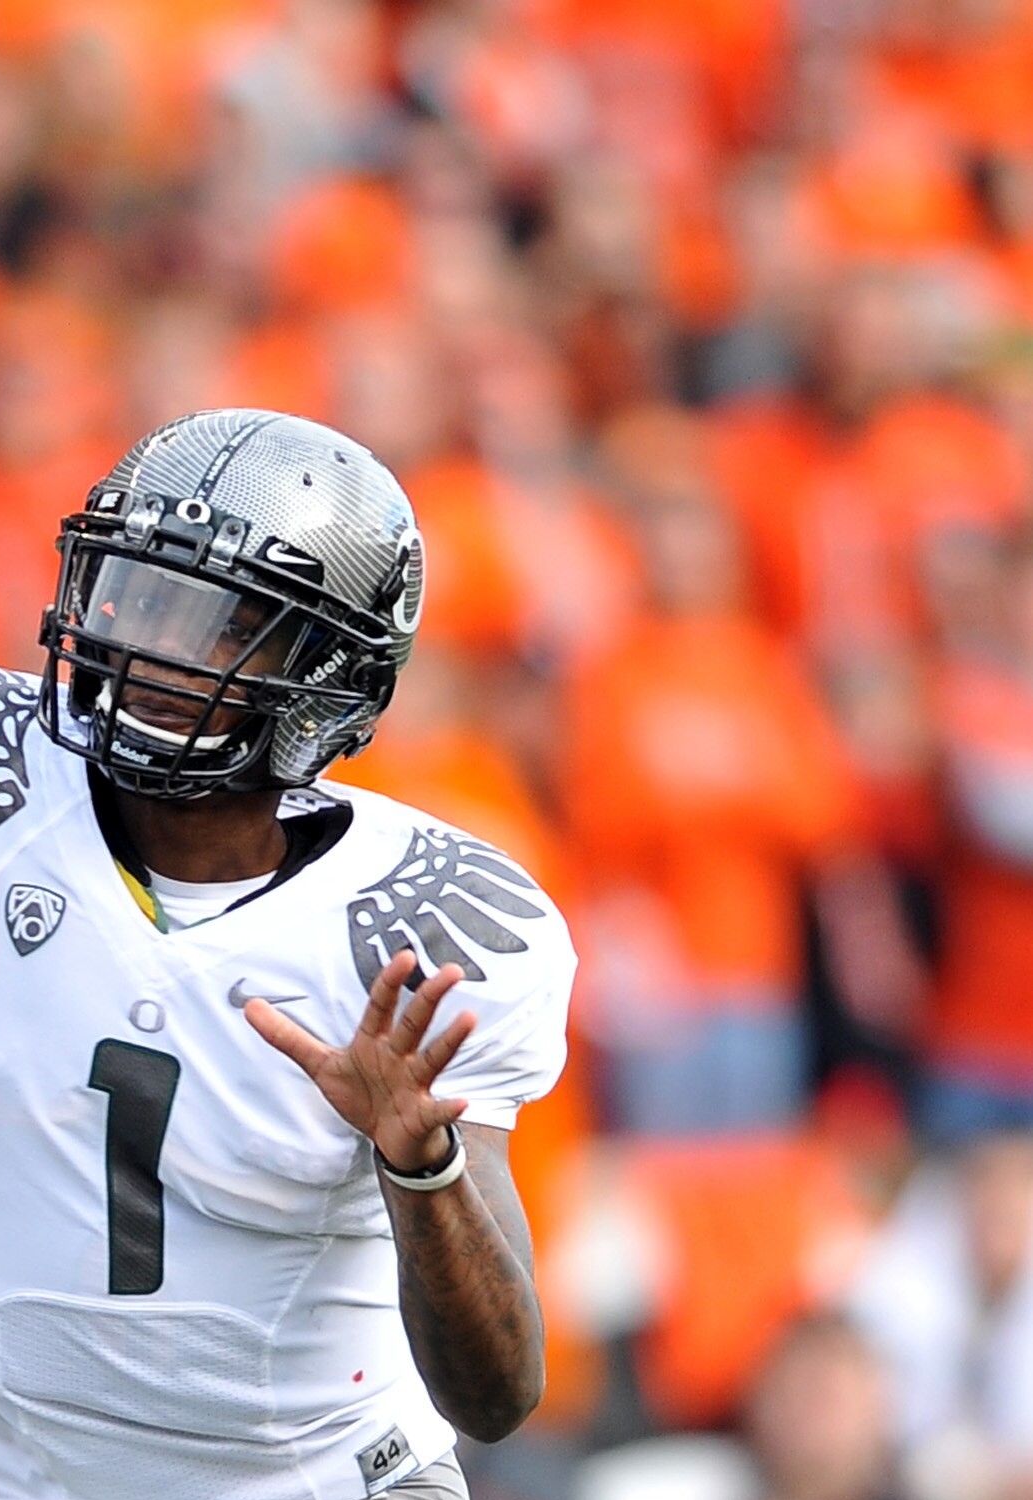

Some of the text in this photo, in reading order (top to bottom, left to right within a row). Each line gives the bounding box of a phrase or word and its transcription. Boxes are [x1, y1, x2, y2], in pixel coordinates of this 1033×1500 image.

[176, 499, 212, 524] O
[8, 885, 65, 934] PAC
[13, 914, 48, 942] 10
[87, 1036, 182, 1294] 1
[372, 1438, 401, 1471] 44
